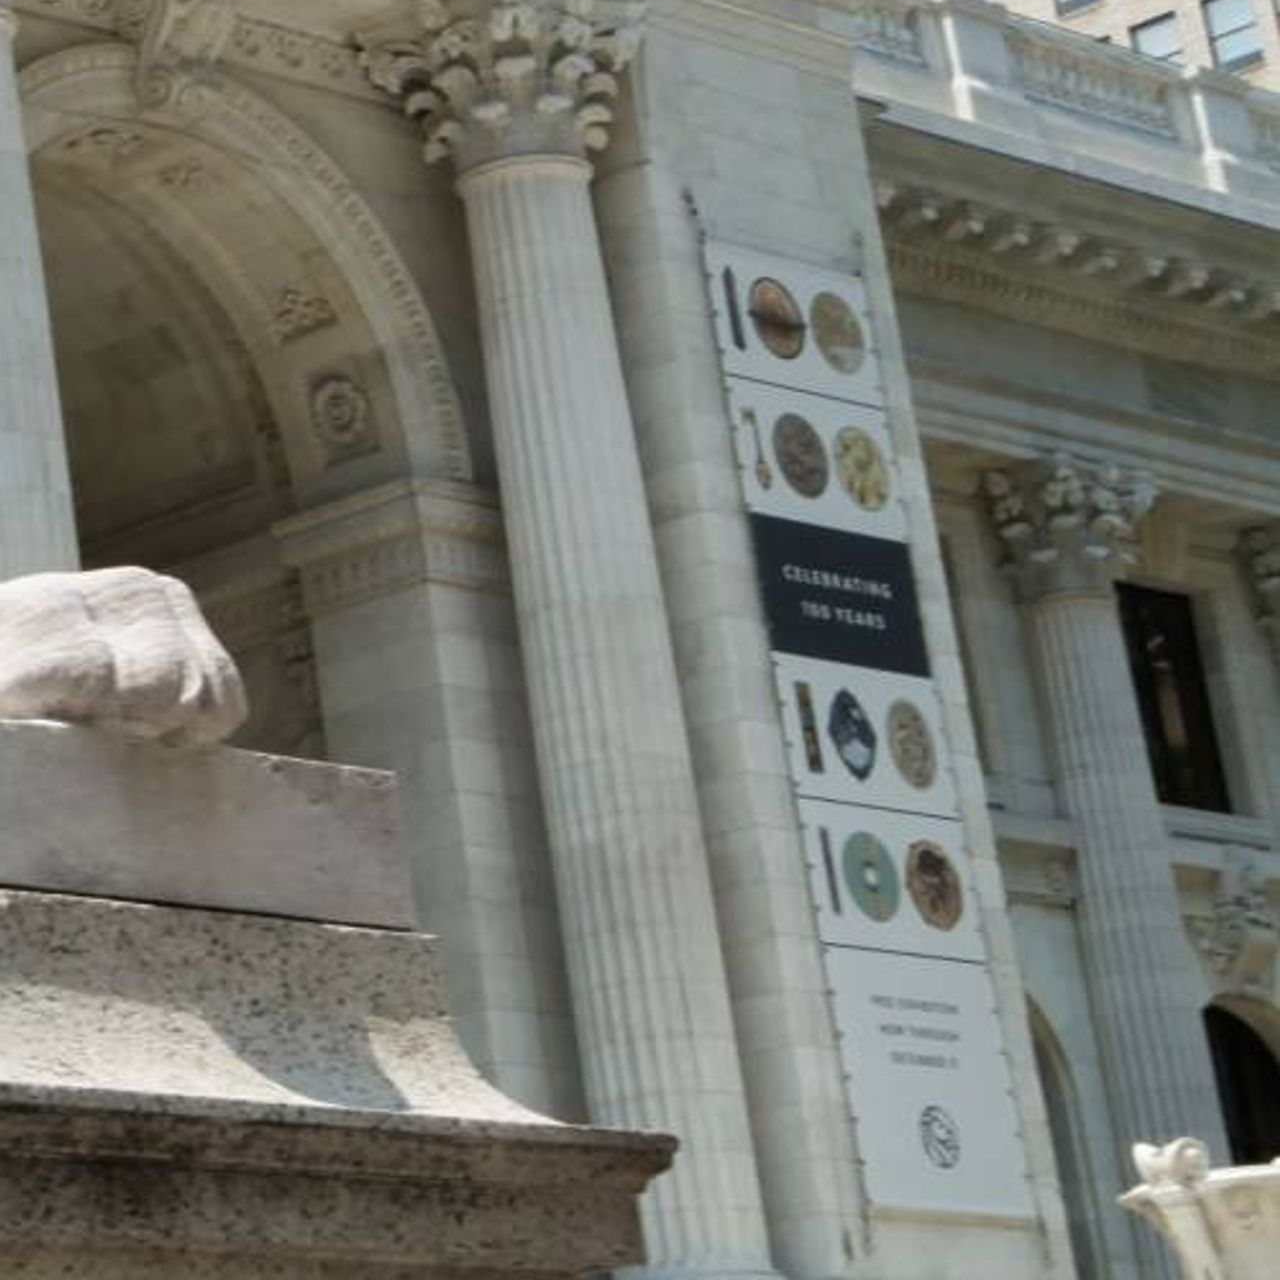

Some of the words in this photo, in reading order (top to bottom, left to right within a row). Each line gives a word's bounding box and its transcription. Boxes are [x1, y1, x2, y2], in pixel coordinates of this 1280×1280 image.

[781, 562, 893, 599] CELEBRATING
[800, 599, 832, 621] 100
[834, 606, 887, 631] YEARS
